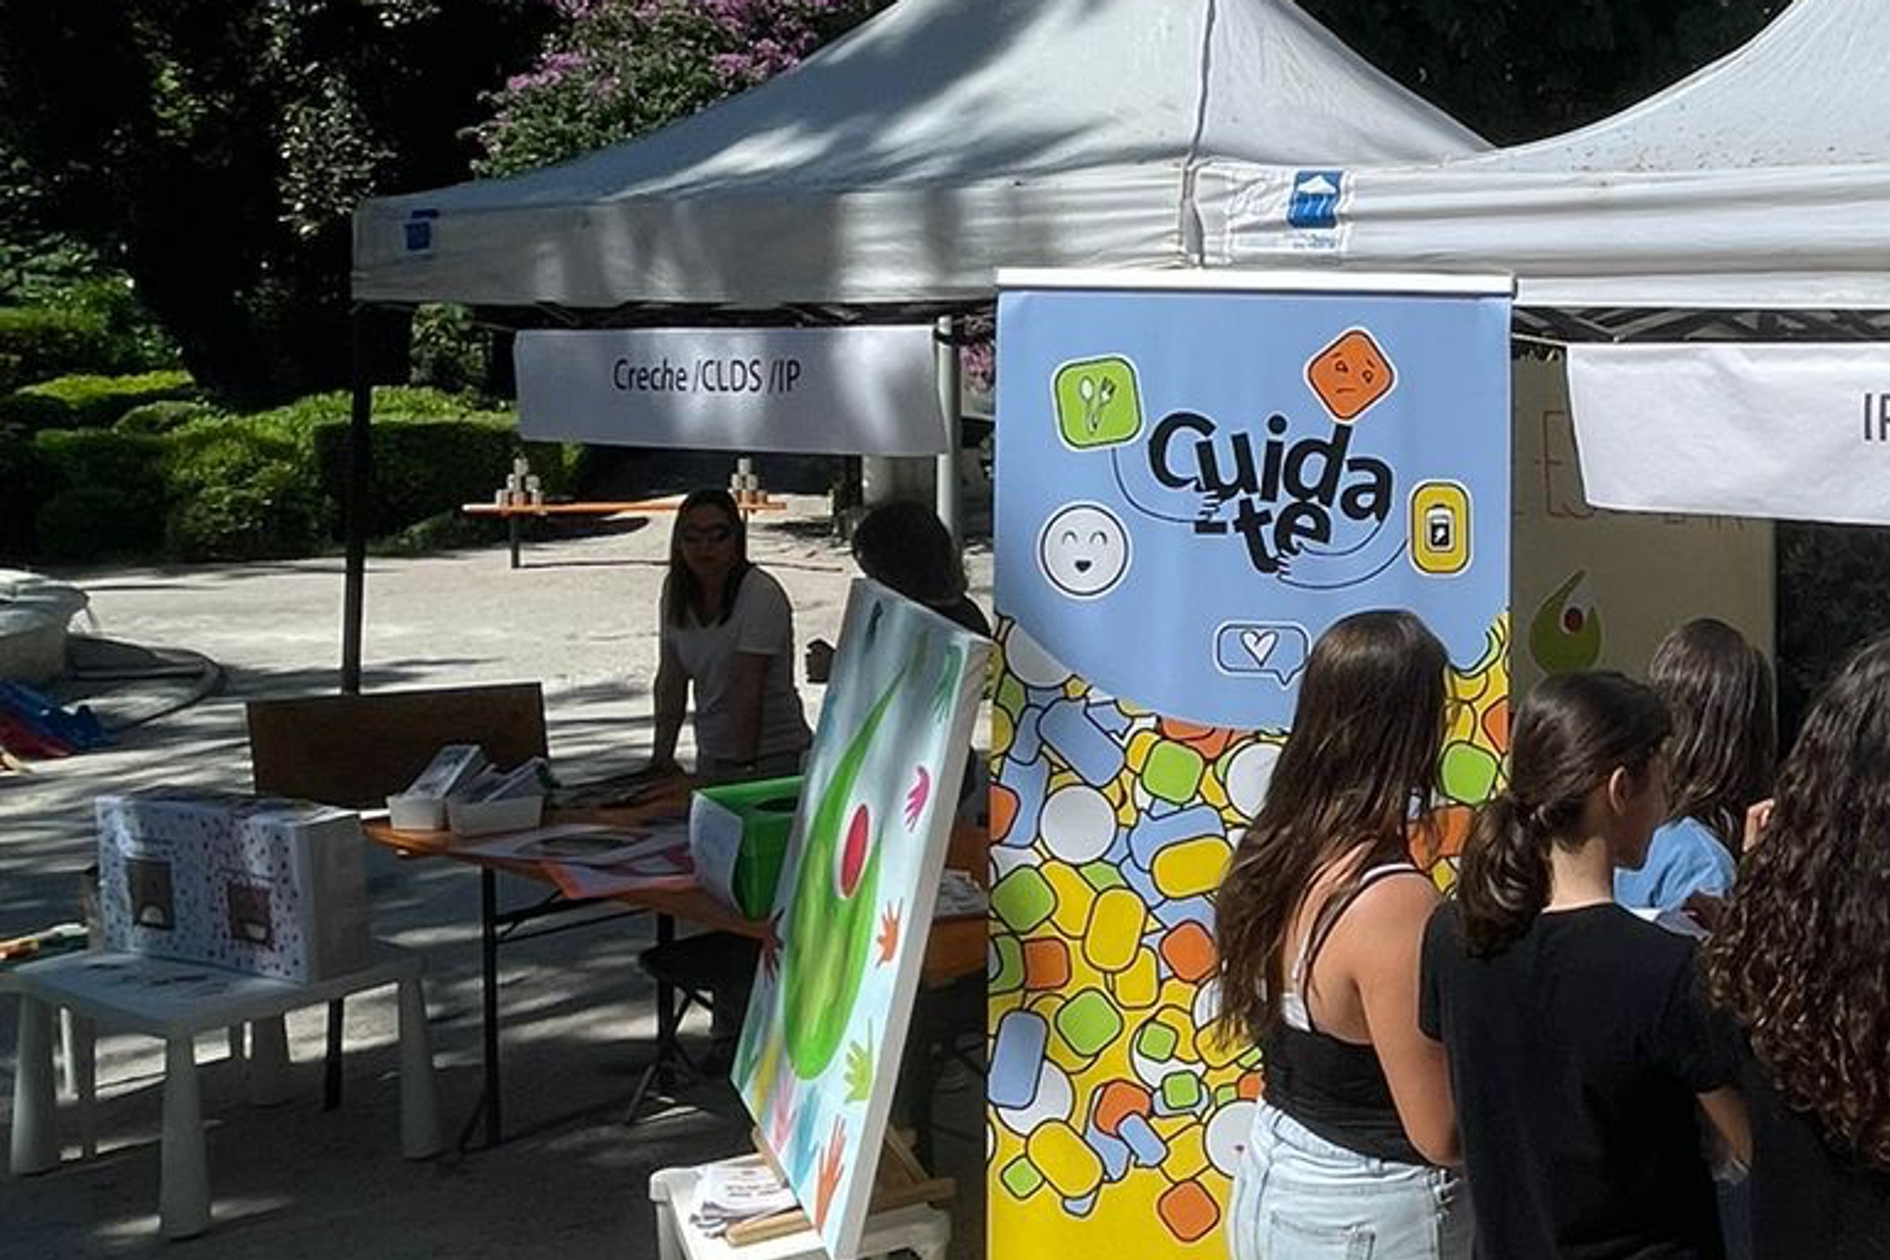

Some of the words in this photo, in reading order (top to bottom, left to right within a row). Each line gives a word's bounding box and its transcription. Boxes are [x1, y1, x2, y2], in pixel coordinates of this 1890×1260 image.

[614, 357, 688, 392] Creche
[691, 360, 763, 393] /CLDS
[767, 360, 801, 394] /IP
[1148, 411, 1394, 522] Cuida
